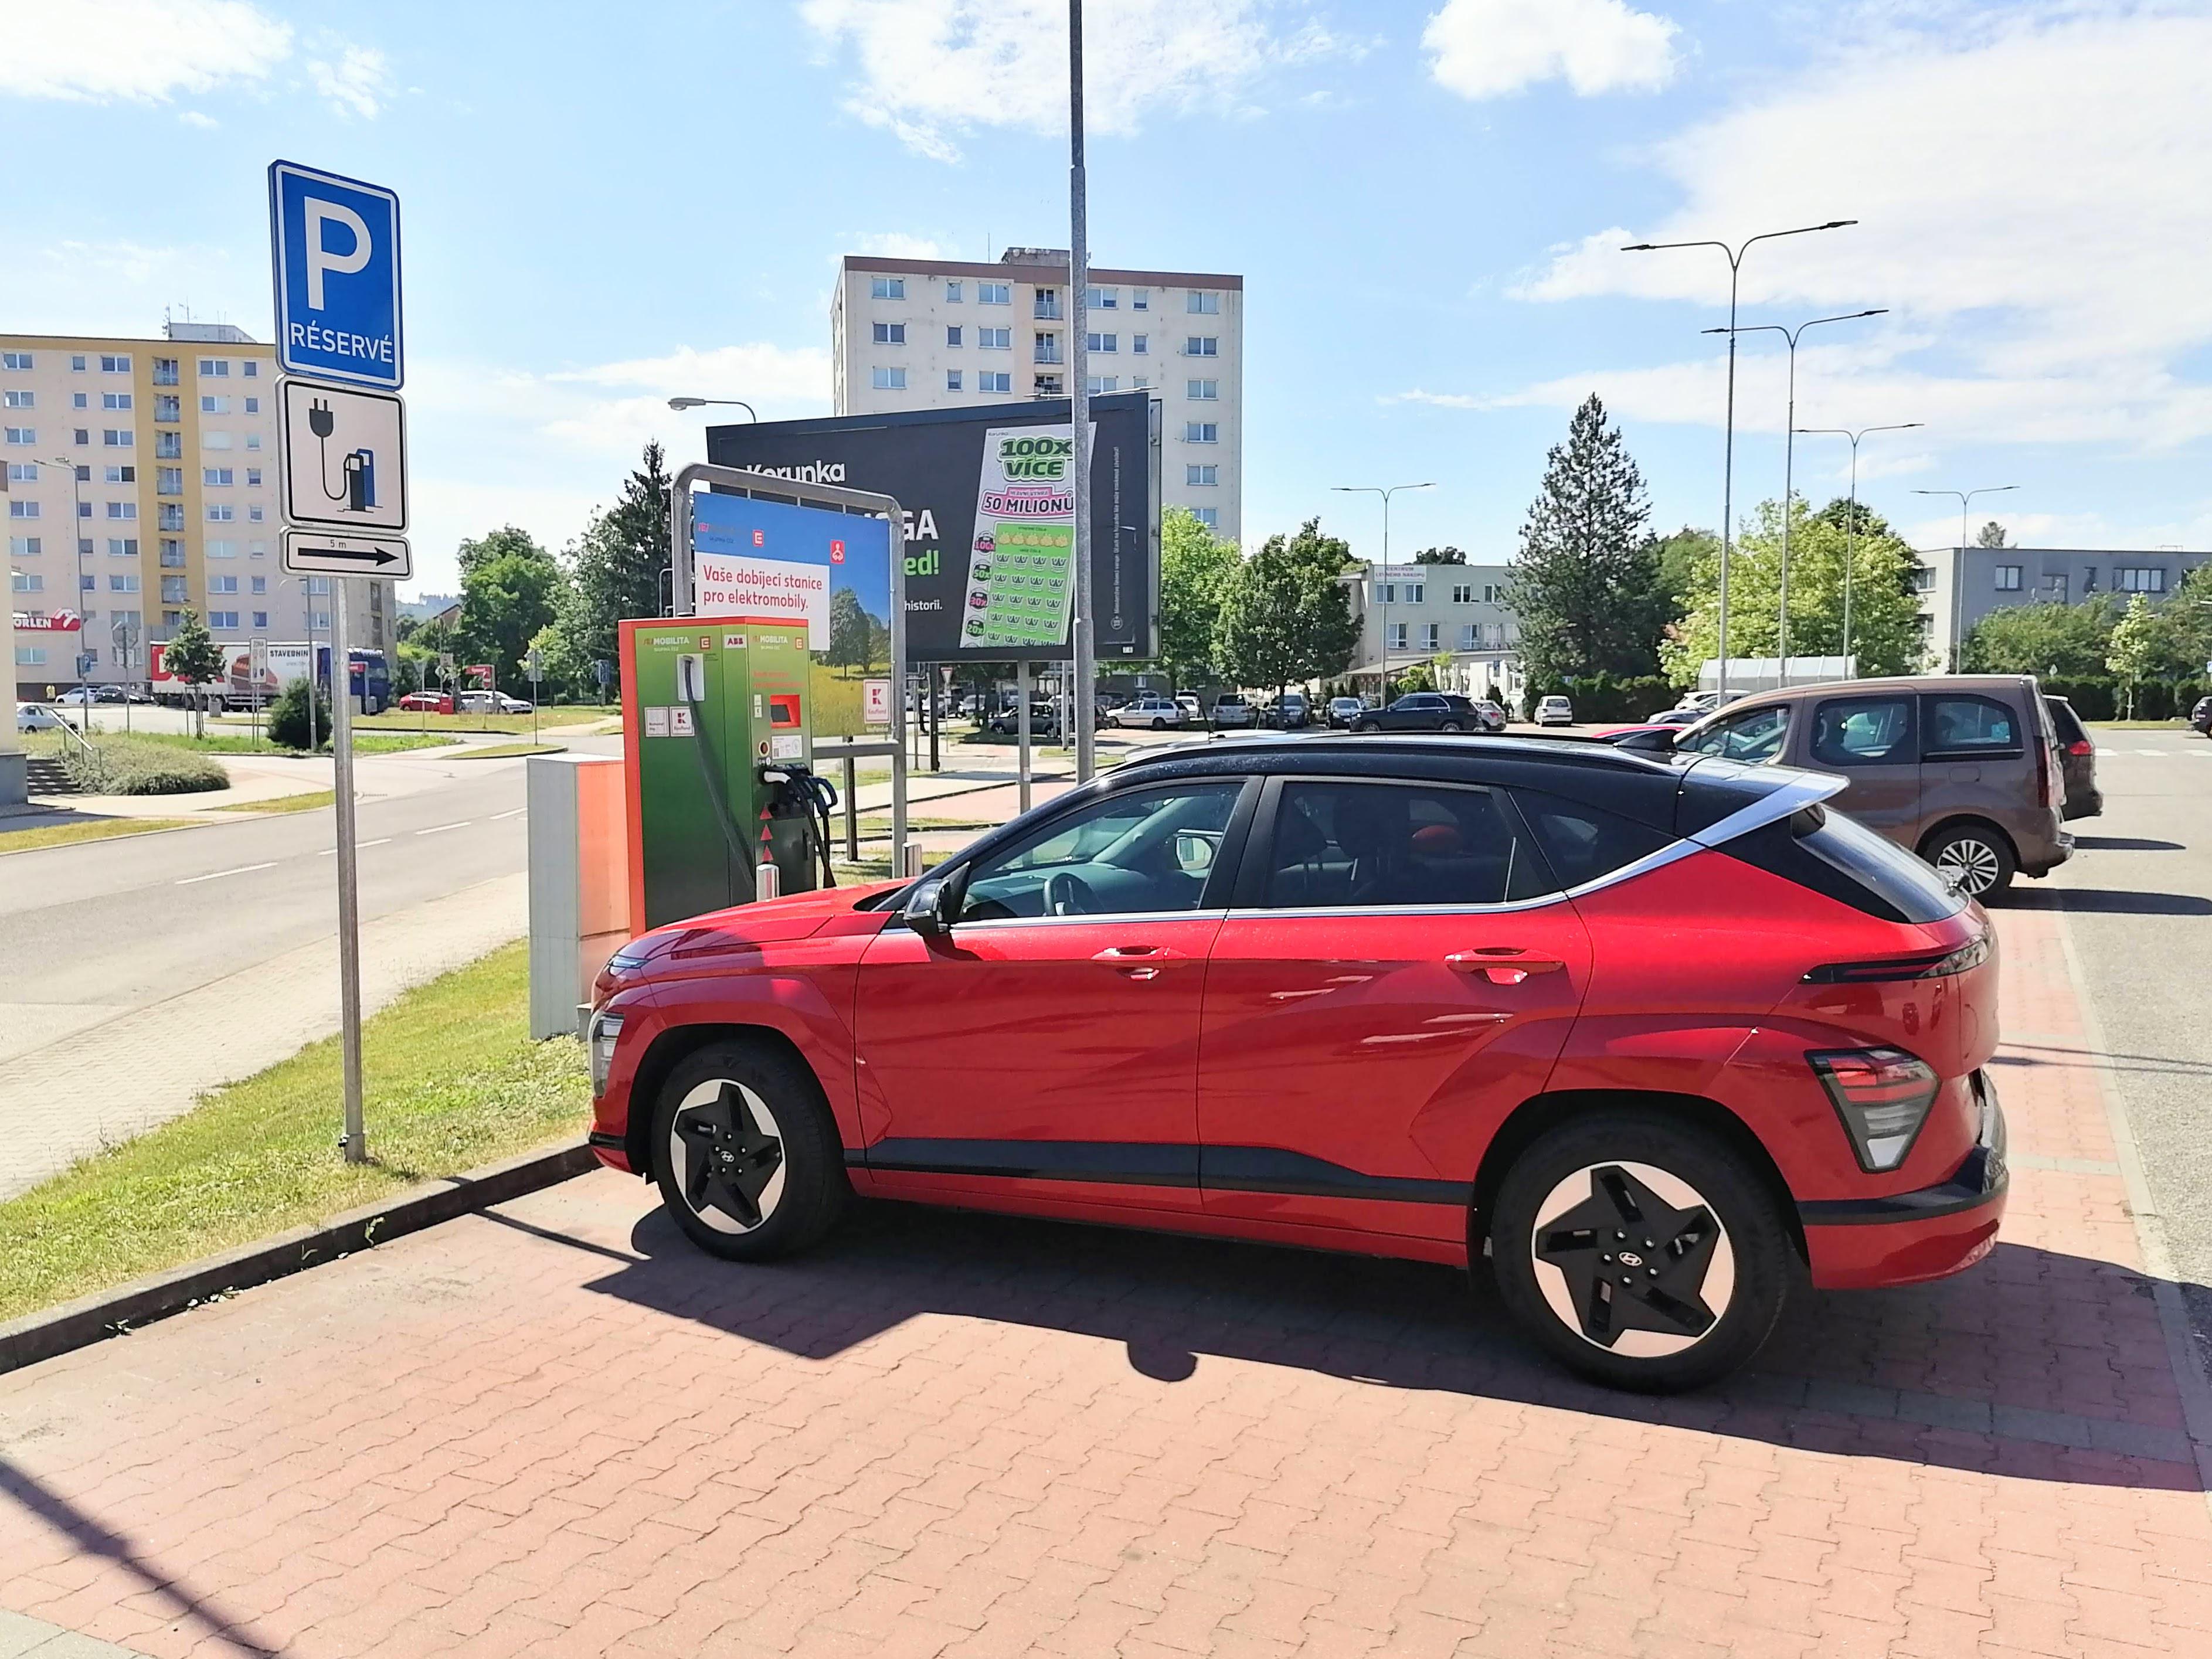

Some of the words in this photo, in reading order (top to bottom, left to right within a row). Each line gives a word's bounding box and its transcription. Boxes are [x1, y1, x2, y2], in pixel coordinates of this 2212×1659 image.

[304, 196, 372, 311] P
[291, 321, 393, 364] RÉSERVÉ
[1001, 439, 1073, 456] 100x
[1006, 457, 1063, 476] VÍCE
[984, 497, 1001, 510] 50
[1005, 492, 1073, 513] MILIONŮ
[330, 539, 335, 548] 5
[703, 565, 732, 582] Vaše
[736, 568, 781, 589] dobíjecí
[784, 575, 823, 590] stanice
[973, 570, 991, 580] 50x
[704, 590, 724, 606] pro
[728, 589, 808, 612] elektromobily.
[904, 599, 943, 612] historii.
[970, 596, 987, 606] 30x
[13, 618, 52, 628] ORLEN
[967, 625, 984, 635] 20x
